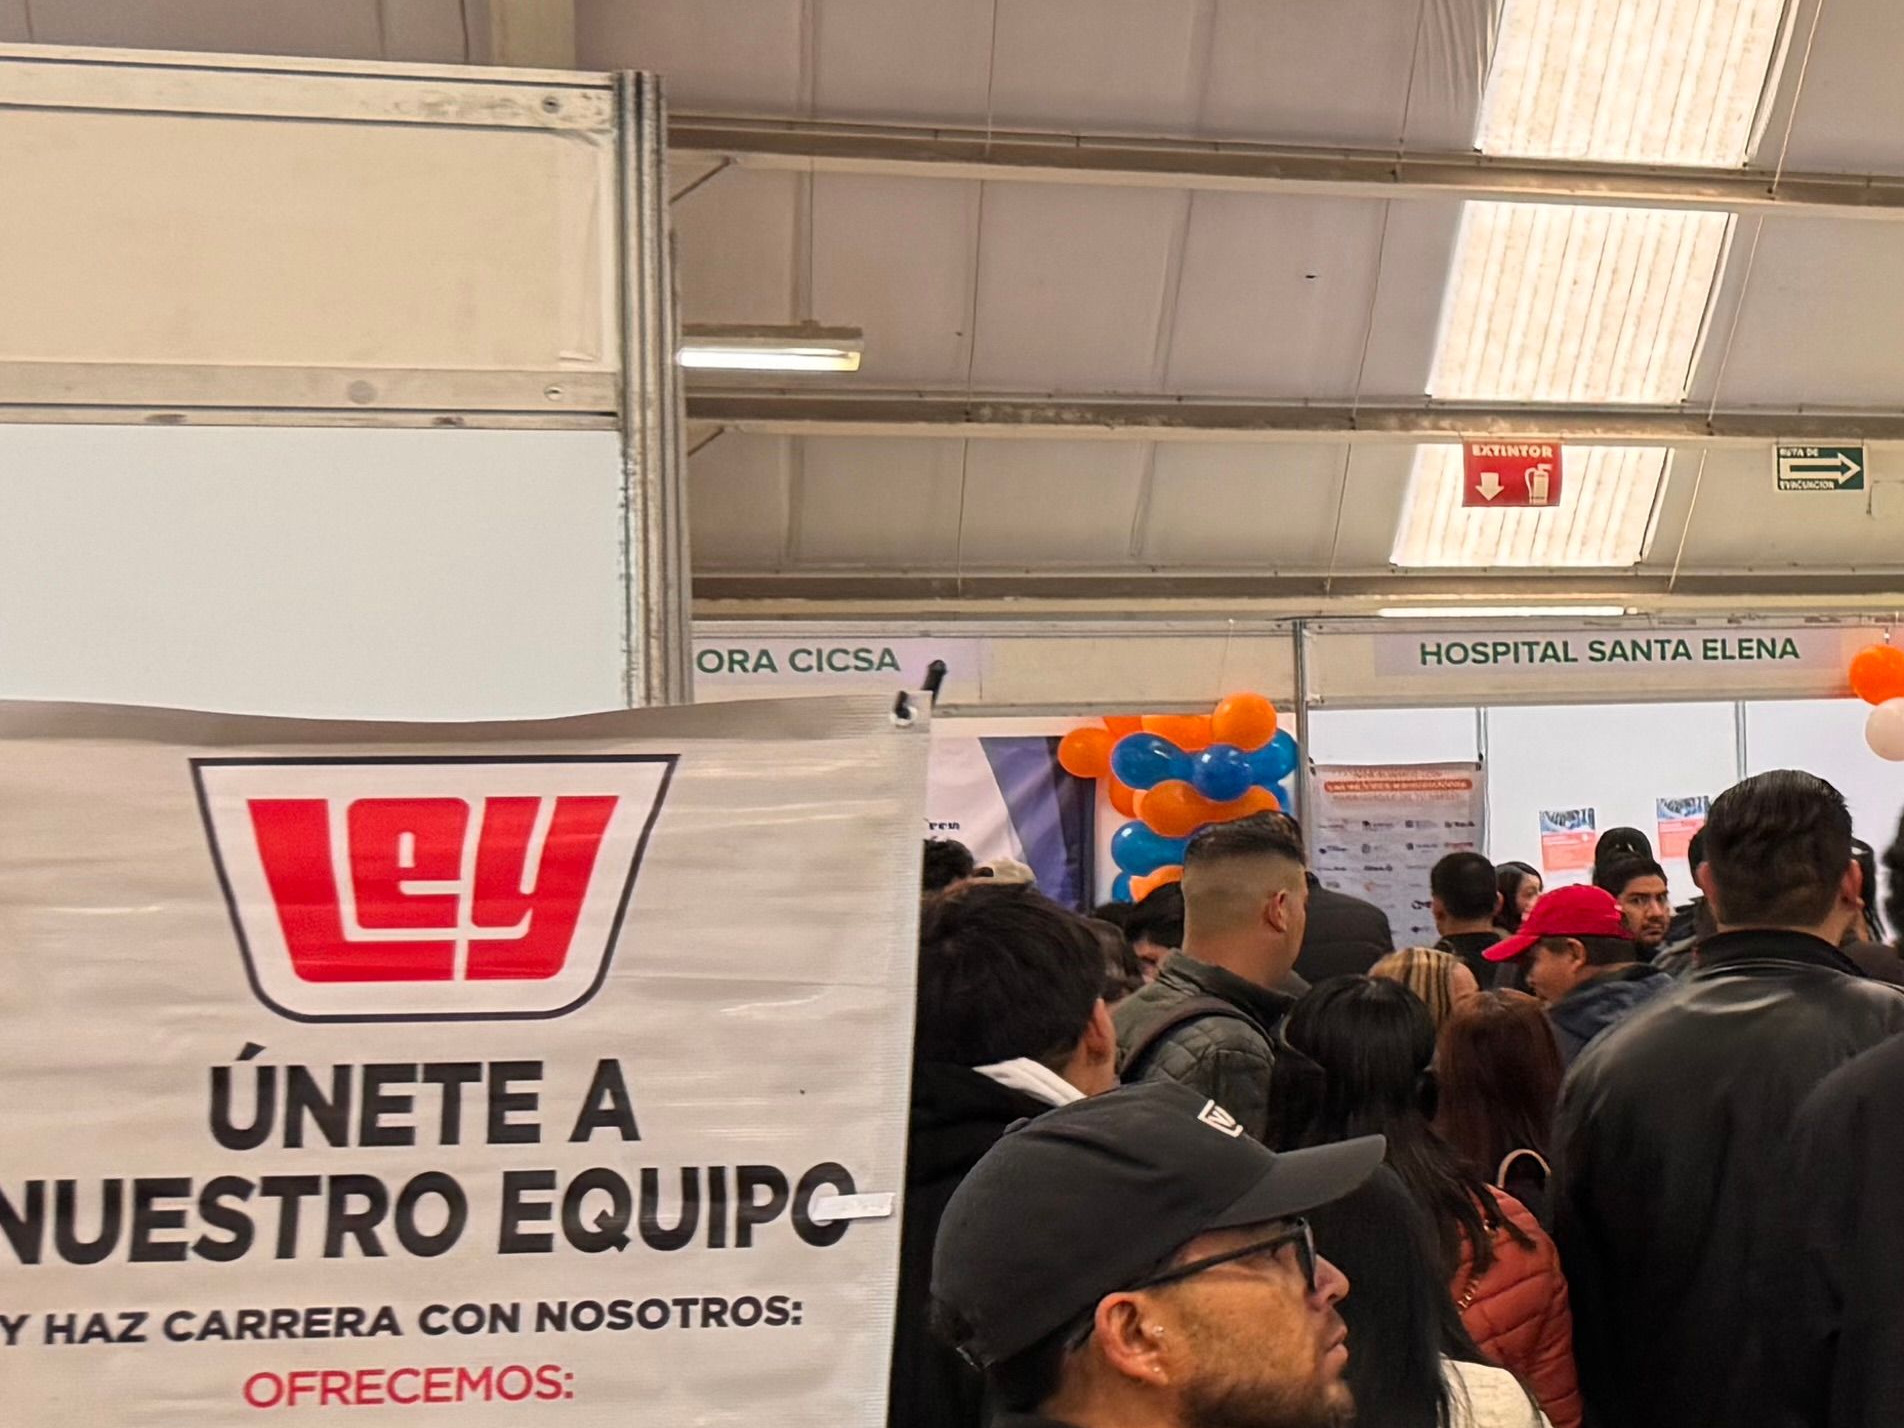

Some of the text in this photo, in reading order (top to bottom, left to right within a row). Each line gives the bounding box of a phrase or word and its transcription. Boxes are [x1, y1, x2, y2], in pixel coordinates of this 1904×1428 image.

[1472, 444, 1553, 459] EXTINTOR
[697, 648, 900, 673] ORA CICSA
[1420, 638, 1800, 666] HOSPITAL SANTA ELENA
[210, 1042, 640, 1149] ÚNETE A
[0, 1161, 857, 1265] NUESTRO EQUIPO
[0, 1295, 803, 1345] Y HAZ CARRERA CON NOSOTROS:
[242, 1365, 576, 1409] OFRECEMOS:
